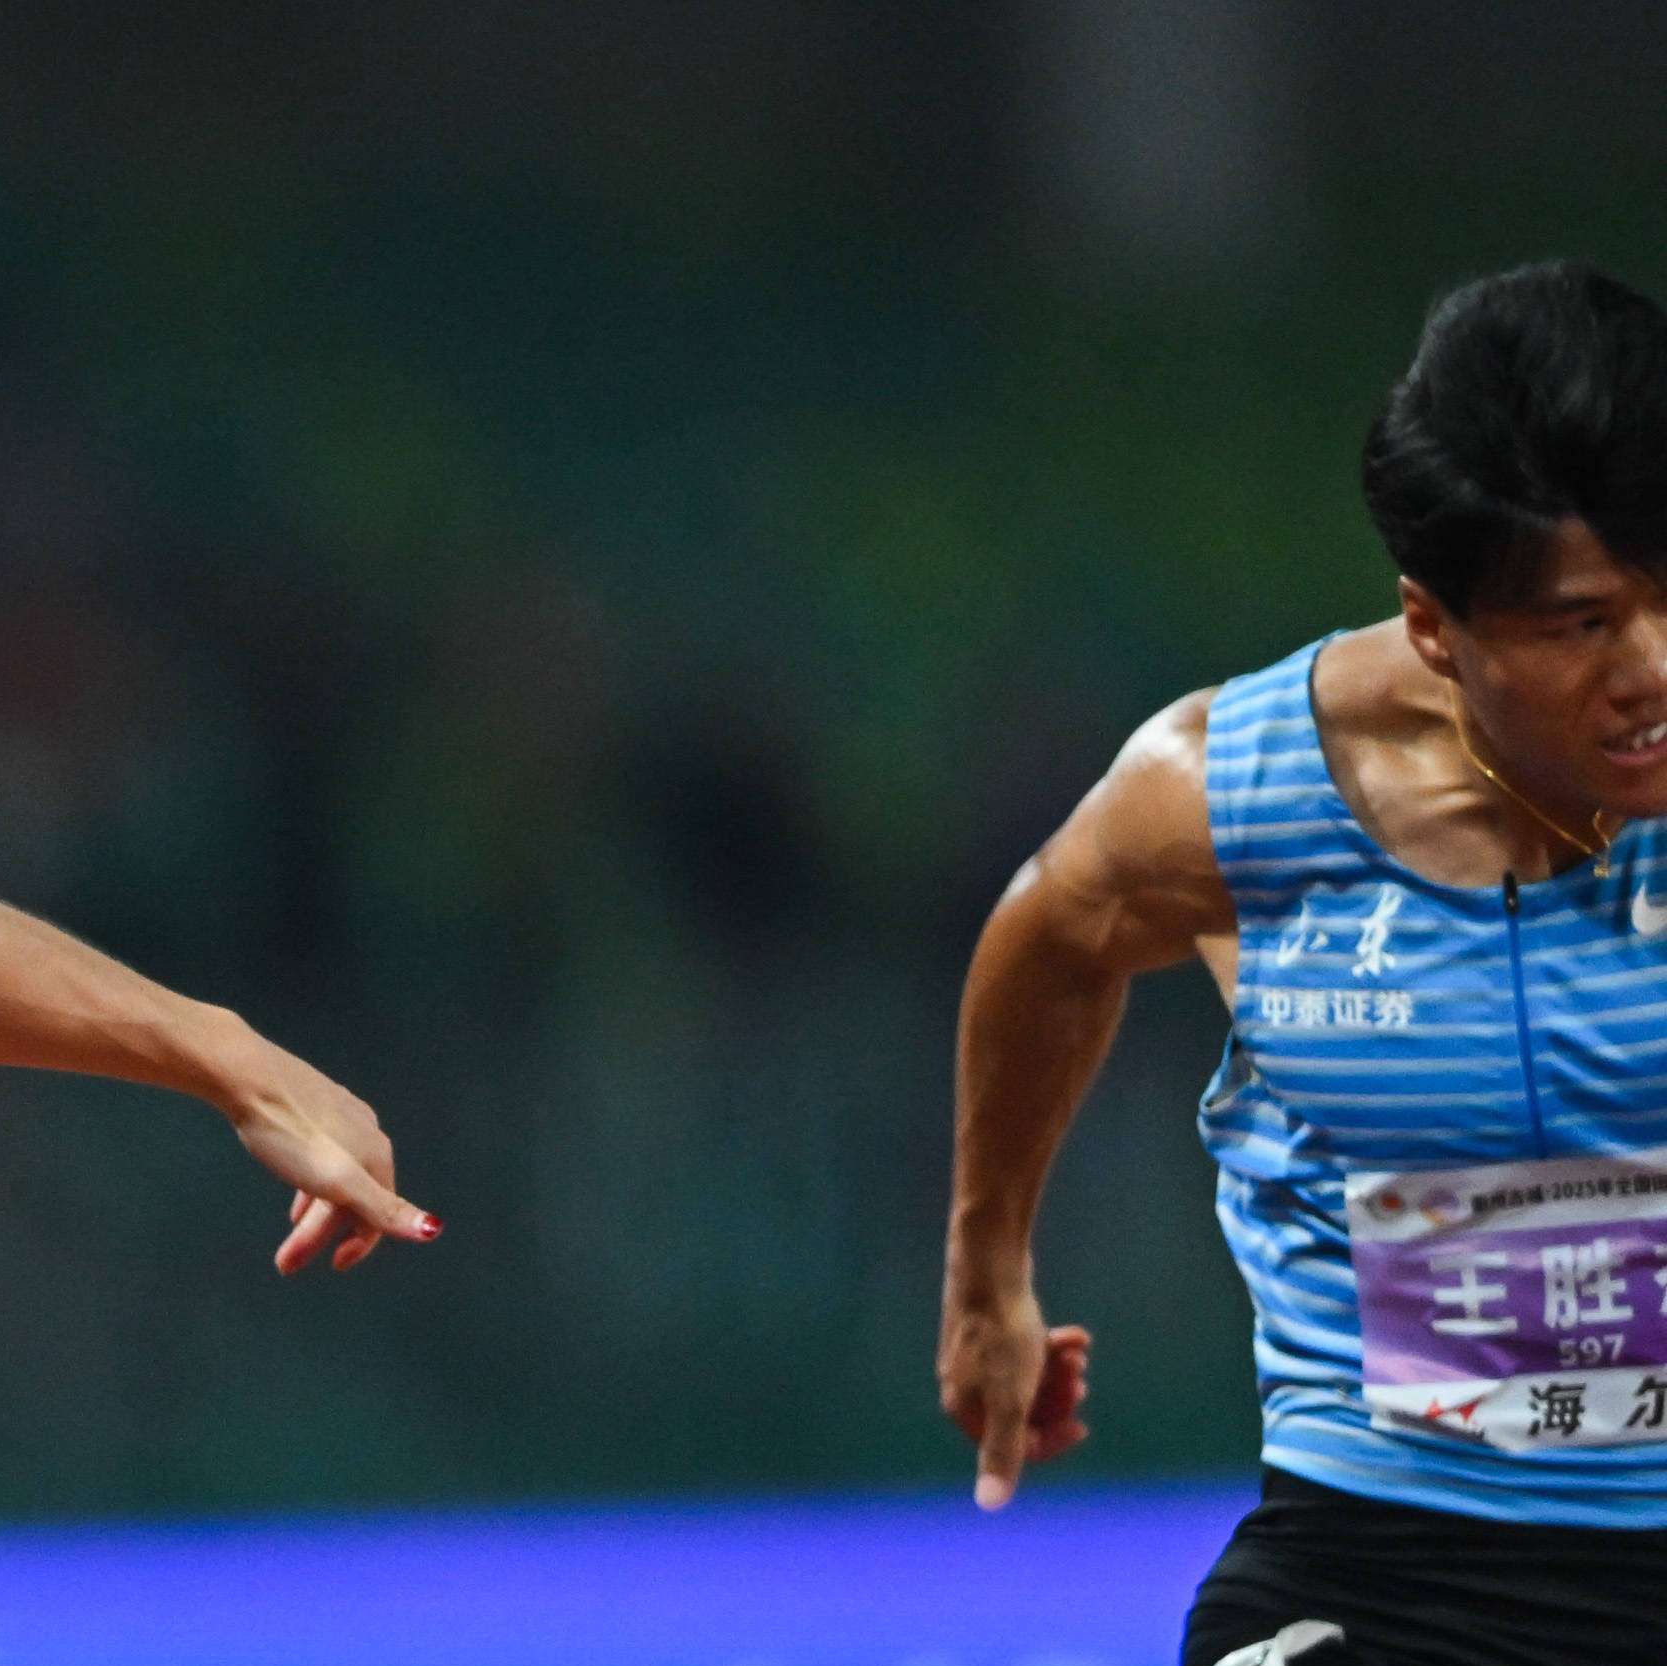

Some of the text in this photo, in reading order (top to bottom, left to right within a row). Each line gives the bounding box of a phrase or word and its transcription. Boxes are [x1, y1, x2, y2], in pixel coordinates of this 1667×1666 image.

[1261, 989, 1413, 1029] 中泰证券
[1429, 1237, 1667, 1336] 王胜
[1558, 1333, 1625, 1368] 597
